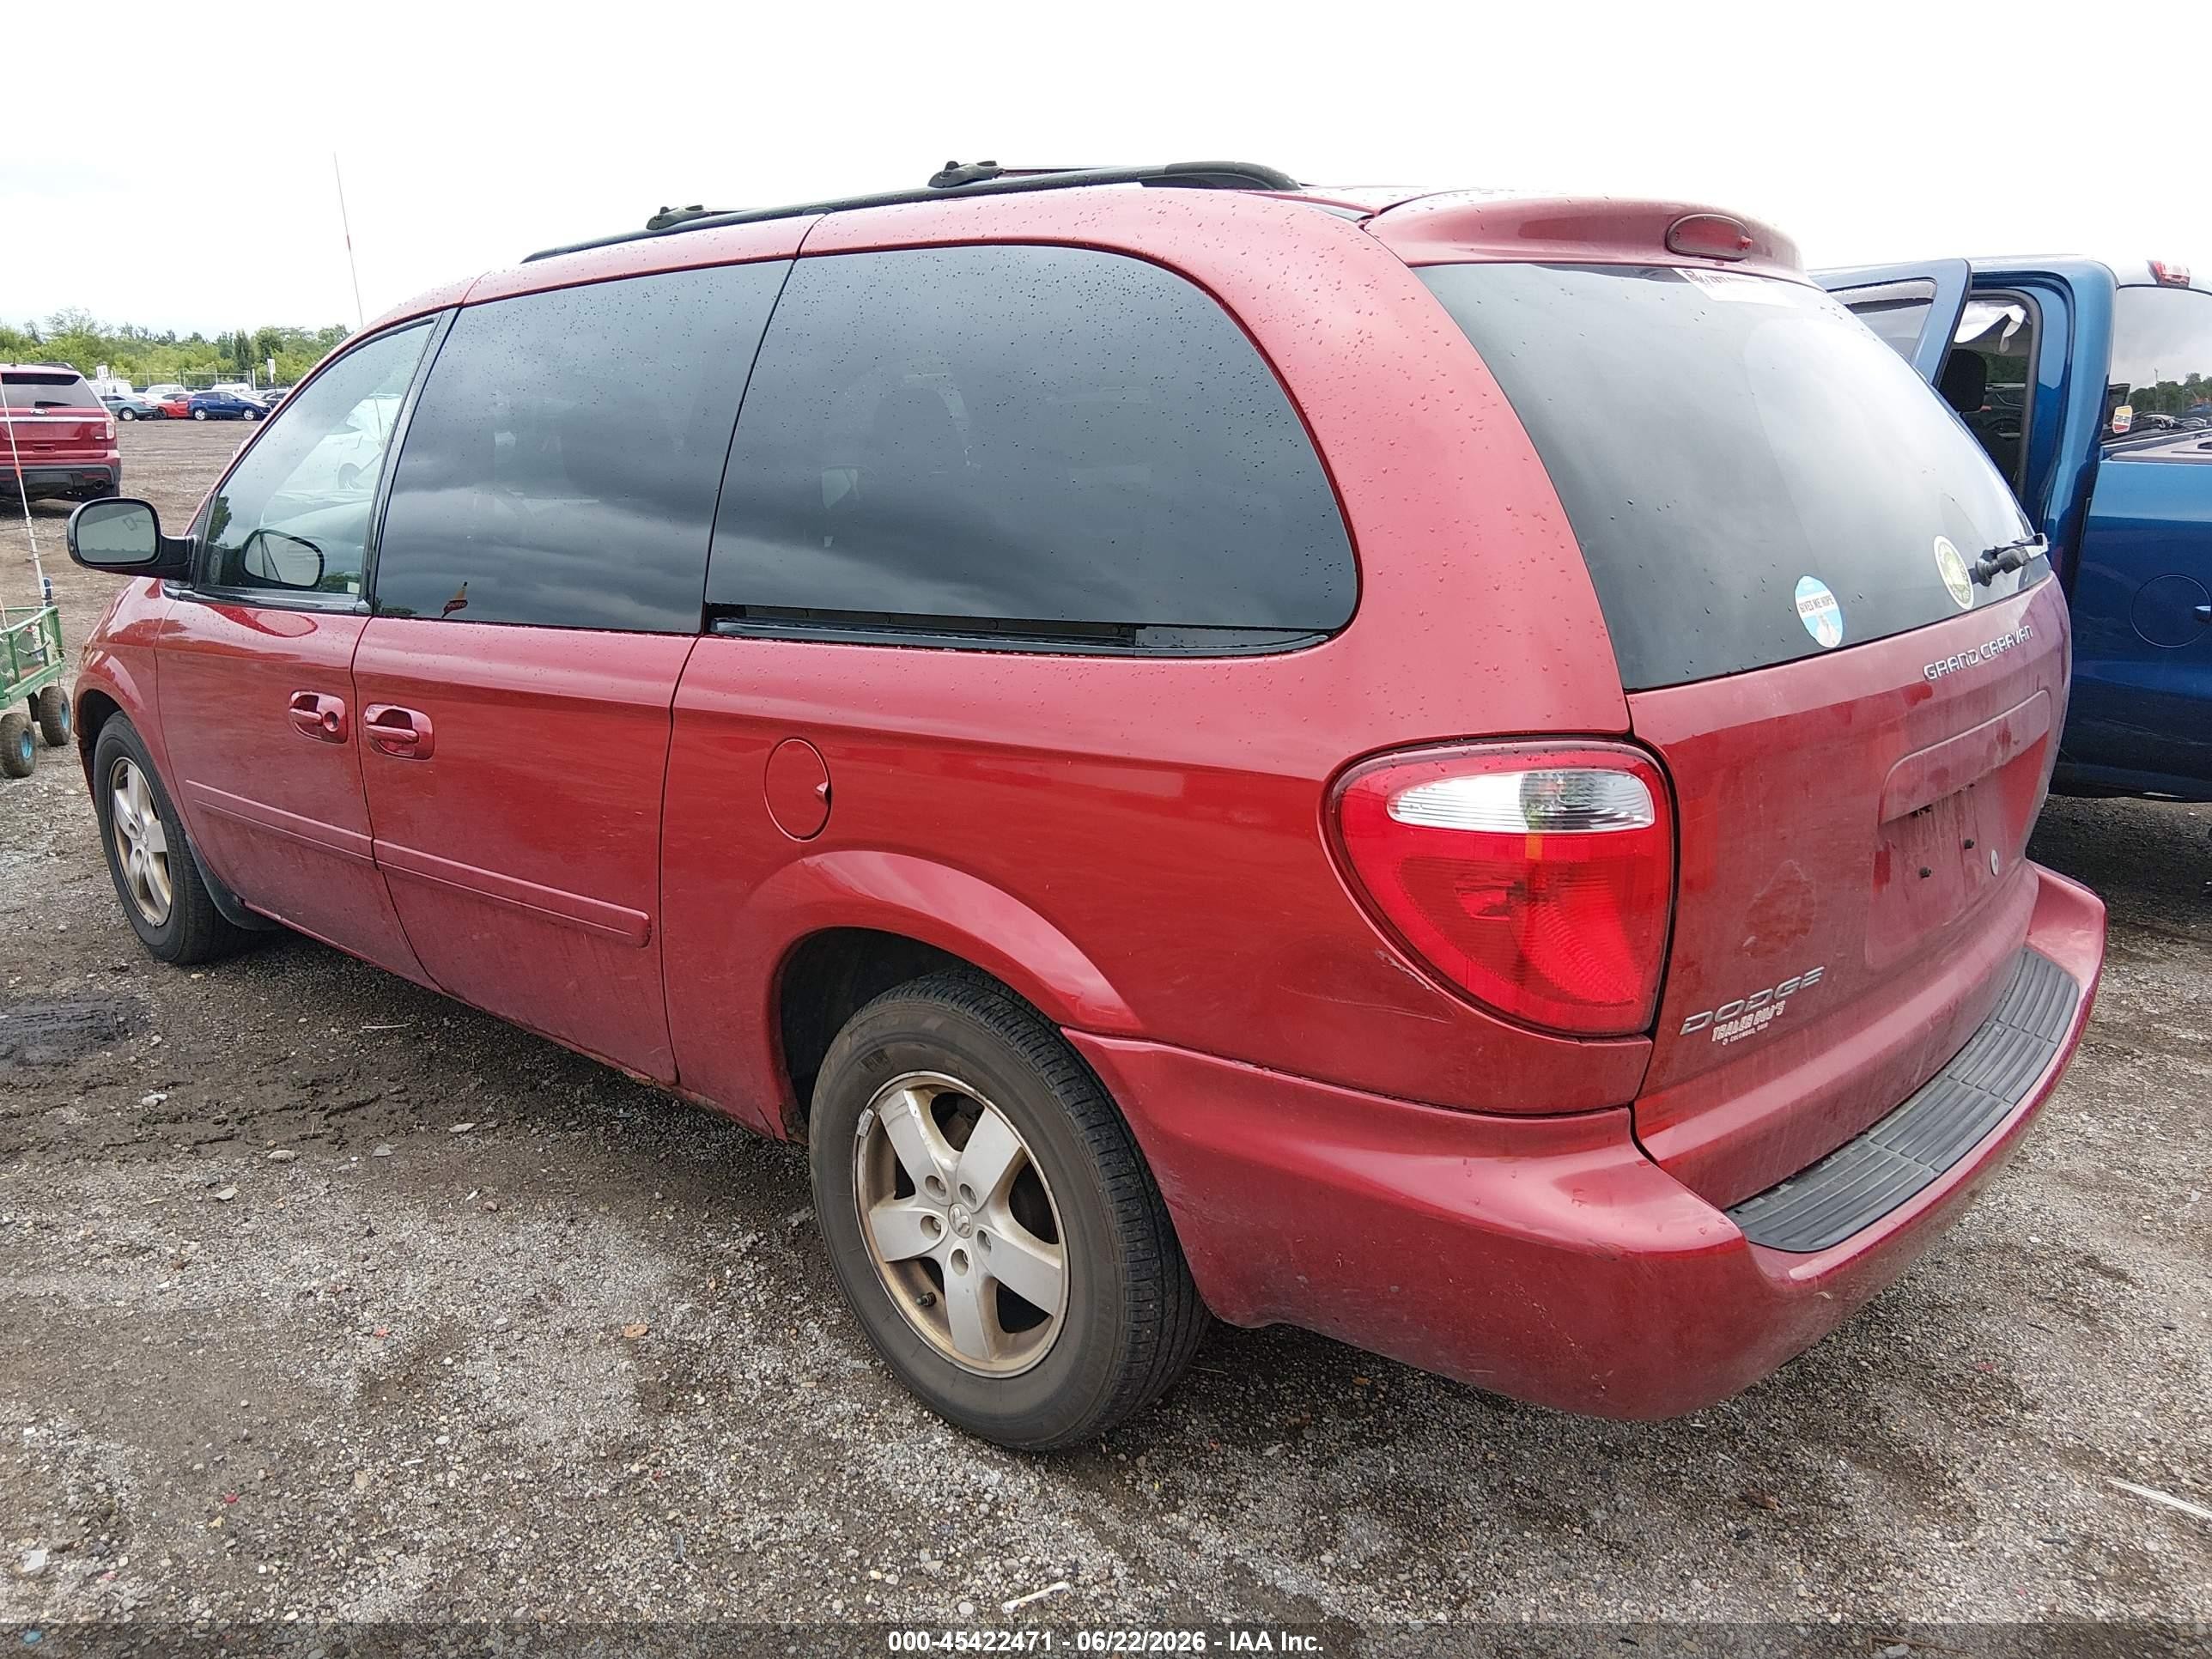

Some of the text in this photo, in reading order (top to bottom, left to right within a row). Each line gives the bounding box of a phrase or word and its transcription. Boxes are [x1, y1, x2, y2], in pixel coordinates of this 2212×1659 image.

[1923, 625, 2034, 681] GRAND CARAVAN
[1679, 965, 1826, 1036] DODGE
